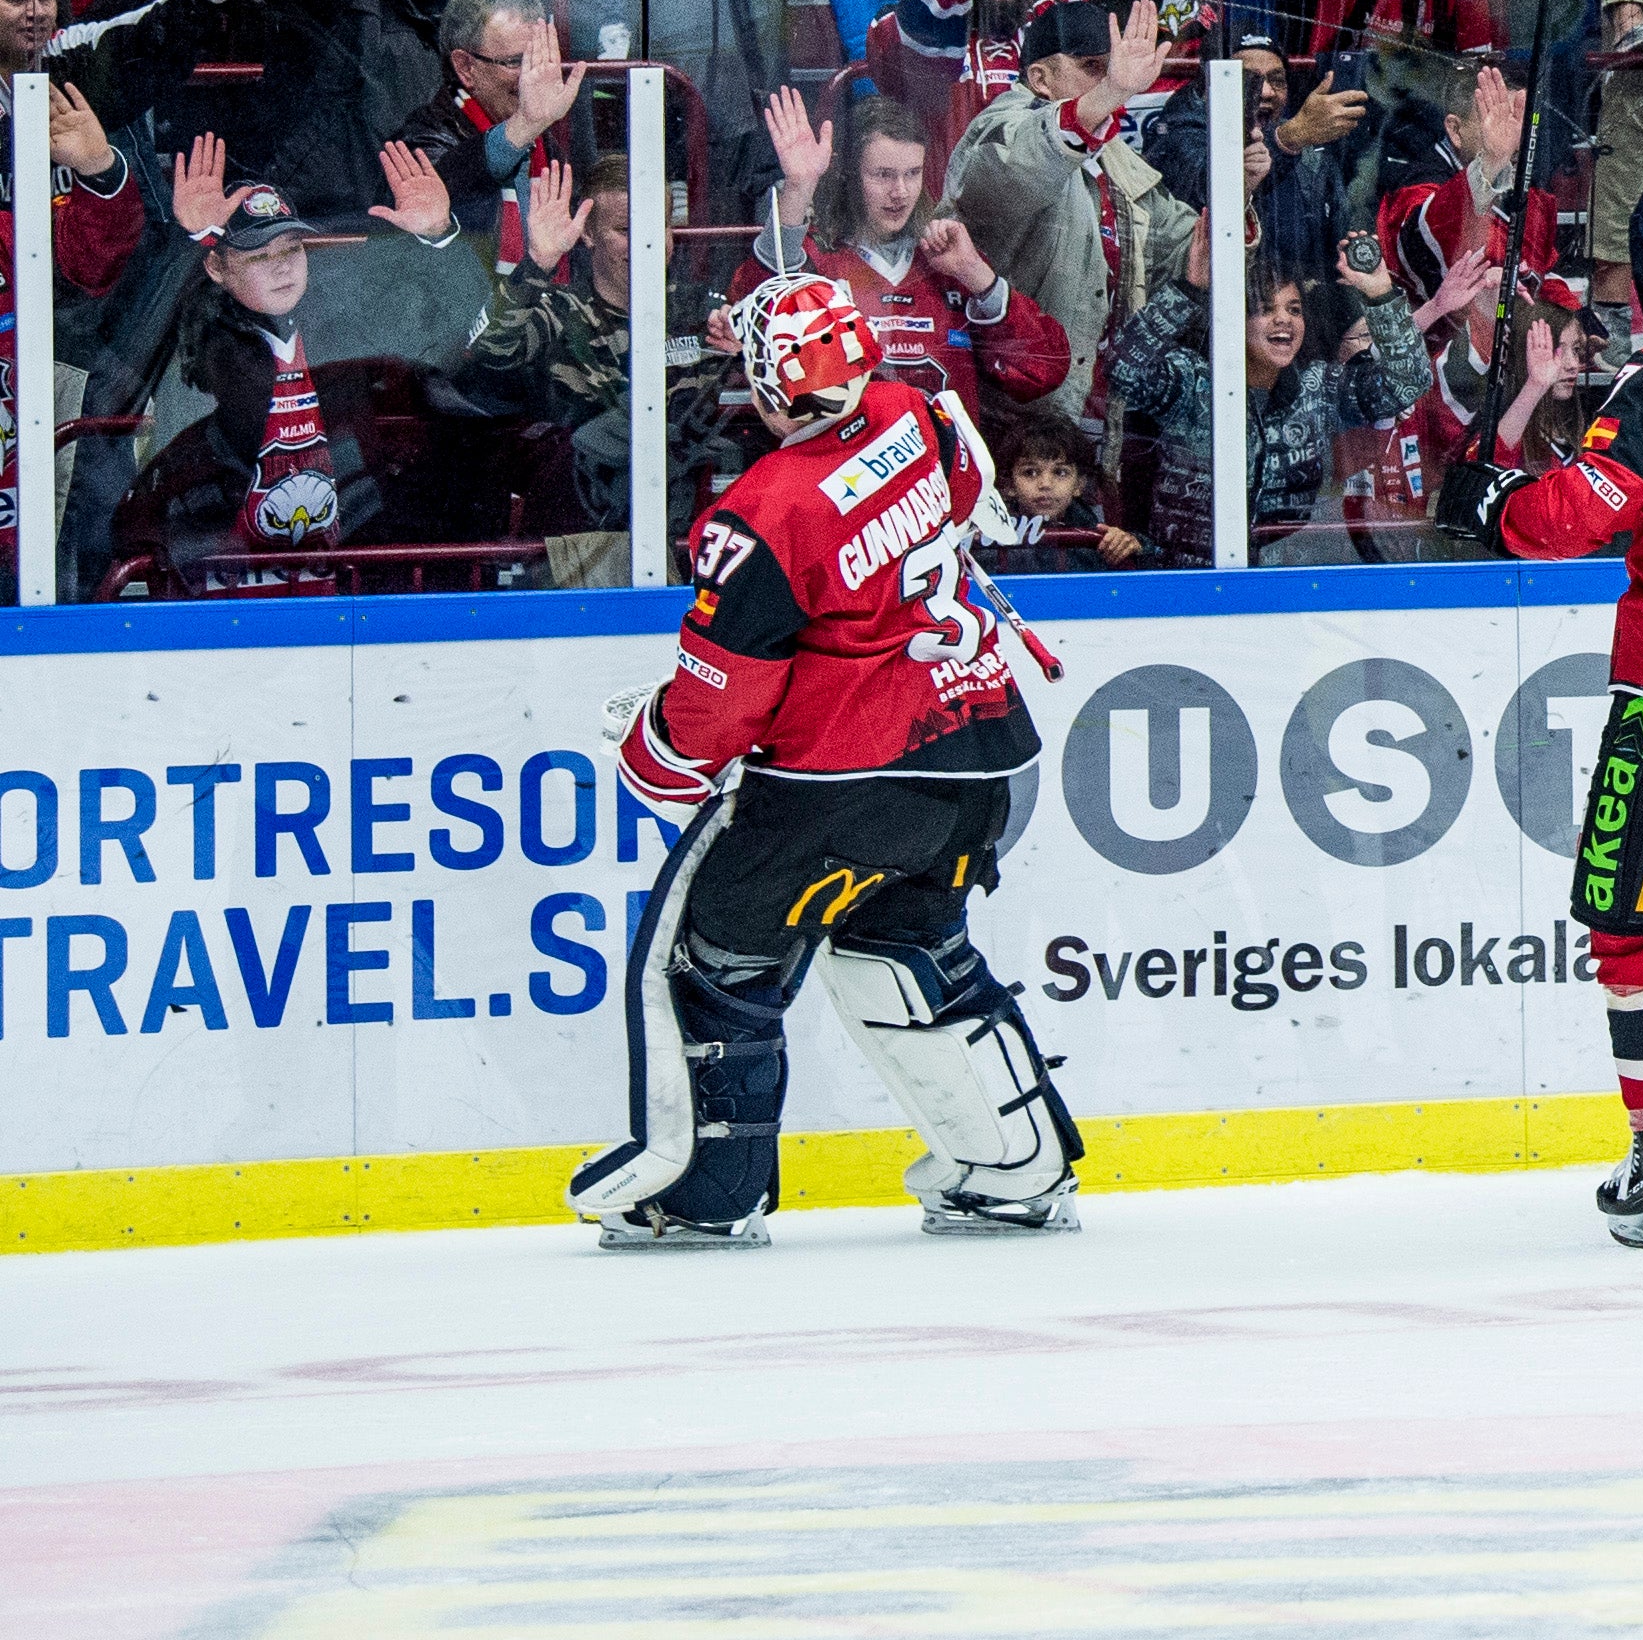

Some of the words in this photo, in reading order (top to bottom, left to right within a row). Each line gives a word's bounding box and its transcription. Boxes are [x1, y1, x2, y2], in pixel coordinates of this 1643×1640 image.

[881, 319, 932, 330] INTERSPORT
[840, 416, 866, 440] CCM
[697, 522, 756, 585] 37
[901, 534, 992, 666] 3
[1584, 759, 1640, 911] akea
[0, 892, 649, 1041] RAVEL.S
[1042, 934, 1368, 1012] Sveriges
